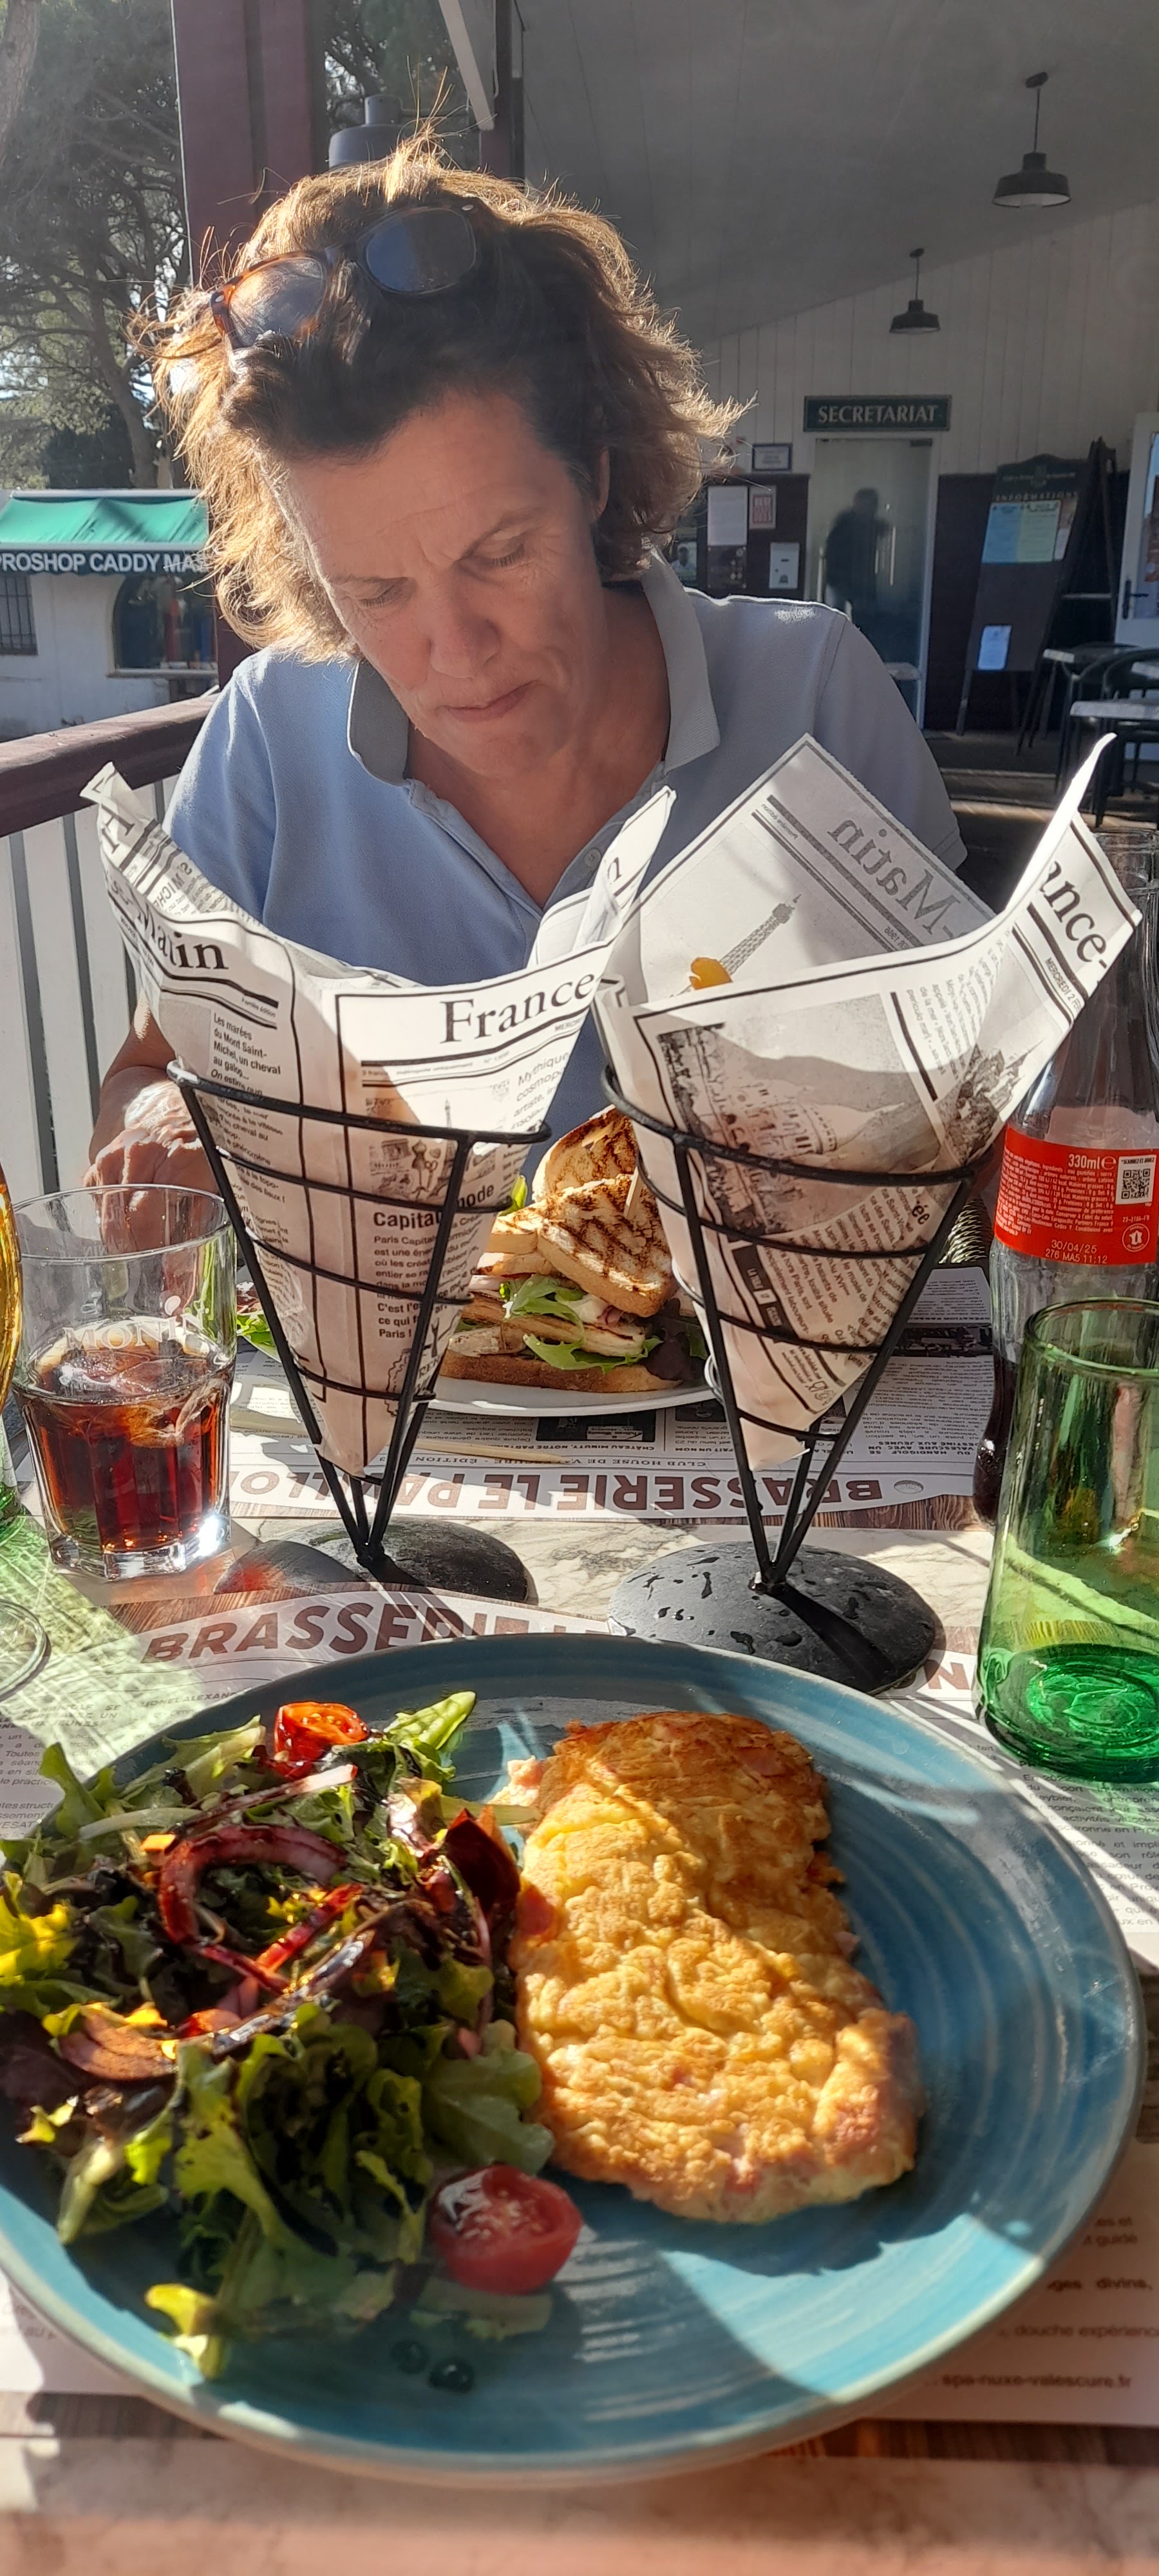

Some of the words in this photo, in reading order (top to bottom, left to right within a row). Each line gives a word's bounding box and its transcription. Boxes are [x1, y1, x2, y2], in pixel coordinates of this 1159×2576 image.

[817, 404, 938, 424] SECRETARIAT
[89, 552, 160, 573] CADDY
[1044, 956, 1072, 996] MERCREDI
[1067, 992, 1076, 1001] 2
[439, 974, 595, 1045] France
[214, 1012, 225, 1027] Les
[223, 1032, 241, 1050] Mont
[213, 1056, 223, 1066] au
[239, 1056, 249, 1067] un
[250, 1060, 281, 1075] cheval
[1068, 1153, 1100, 1170] 330ml
[373, 1235, 399, 1244] Paris
[391, 1249, 410, 1257] une
[1045, 1247, 1060, 1260] 276
[1062, 1251, 1081, 1263] MA5
[1083, 1254, 1108, 1264] 11:12
[390, 1258, 404, 1267] les
[375, 1270, 403, 1279] entier
[377, 1302, 404, 1313] C'est
[818, 1300, 834, 1324] située
[378, 1316, 390, 1325] ce
[393, 1316, 410, 1327] qui
[379, 1328, 406, 1339] Paris
[416, 1455, 480, 1464] ÉDITION
[230, 1470, 466, 1509] PALLO
[478, 1473, 542, 1511] LE
[12, 1778, 53, 1786] practic
[1095, 2277, 1153, 2293] divins,
[1014, 2325, 1074, 2337] douche
